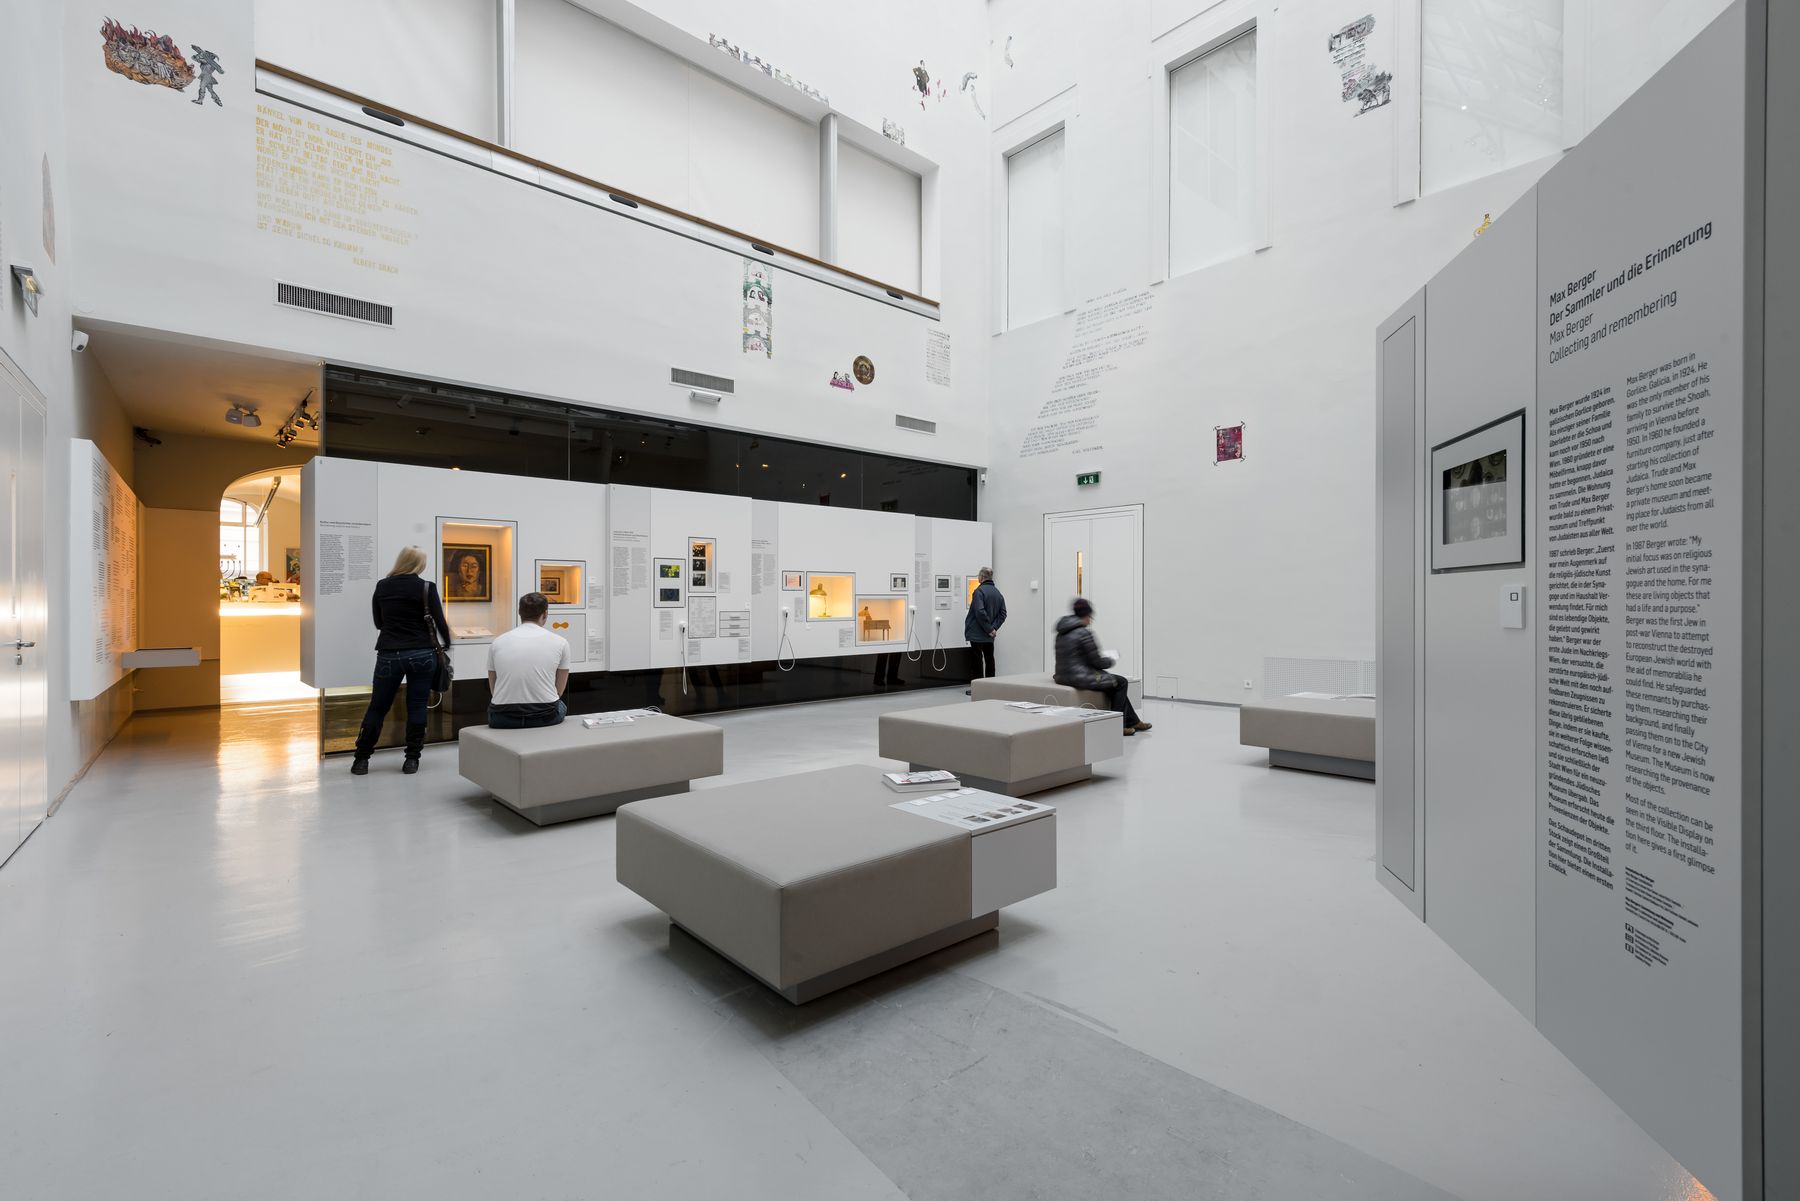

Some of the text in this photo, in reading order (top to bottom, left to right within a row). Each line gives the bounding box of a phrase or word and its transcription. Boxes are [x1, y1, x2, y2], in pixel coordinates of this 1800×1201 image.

[1549, 220, 1712, 326] Der Sammler und die Erinnerung
[1549, 269, 1596, 307] Max Berger
[1549, 289, 1677, 364] Collecting and remembering
[1549, 312, 1592, 345] Max Berger
[1626, 352, 1695, 385] Max Berger was born in
[1671, 372, 1679, 381] in
[1697, 361, 1708, 371] He
[1626, 373, 1710, 410] was the only member of his
[1626, 409, 1644, 422] family
[1644, 408, 1652, 416] to
[1651, 400, 1674, 414] survive
[1674, 396, 1686, 406] the
[1626, 405, 1699, 435] arriving in Vienna before
[1641, 433, 1648, 442] In
[1663, 427, 1672, 436] he
[1672, 417, 1700, 434] founded
[1700, 417, 1706, 426] a
[1626, 446, 1652, 459] furniture
[1682, 433, 1696, 446] just
[1696, 429, 1714, 441] after
[1626, 444, 1699, 472] starting his collection of
[1651, 466, 1668, 477] Trude
[1668, 463, 1682, 474] and
[1682, 461, 1696, 471] Max
[1649, 481, 1667, 491] home
[1667, 477, 1684, 487] soon
[1684, 472, 1712, 484] became
[1625, 500, 1630, 508] a
[1630, 496, 1650, 509] private
[1651, 492, 1678, 503] museum
[1679, 487, 1693, 499] and
[1625, 497, 1714, 522] ing place for Judaists from all
[1625, 523, 1638, 532] over
[1638, 521, 1649, 530] the
[1625, 542, 1631, 551] In
[1632, 540, 1645, 550] 1987
[1645, 539, 1666, 550] Berger
[1625, 548, 1712, 563] initial focus was on religious
[1625, 579, 1643, 589] gogue
[1643, 577, 1655, 587] and
[1655, 577, 1666, 586] the
[1687, 575, 1699, 585] For
[1699, 577, 1712, 585] me
[1625, 615, 1706, 626] Berger was the first Jew in
[1624, 792, 1713, 831] Most of the collection can be
[1625, 805, 1713, 845] seen in the Visible Display on
[1625, 817, 1635, 828] the
[1635, 821, 1650, 834] third
[1667, 832, 1679, 845] The
[1624, 841, 1632, 850] of
[1625, 829, 1715, 875] tion here gives a first glimpse
